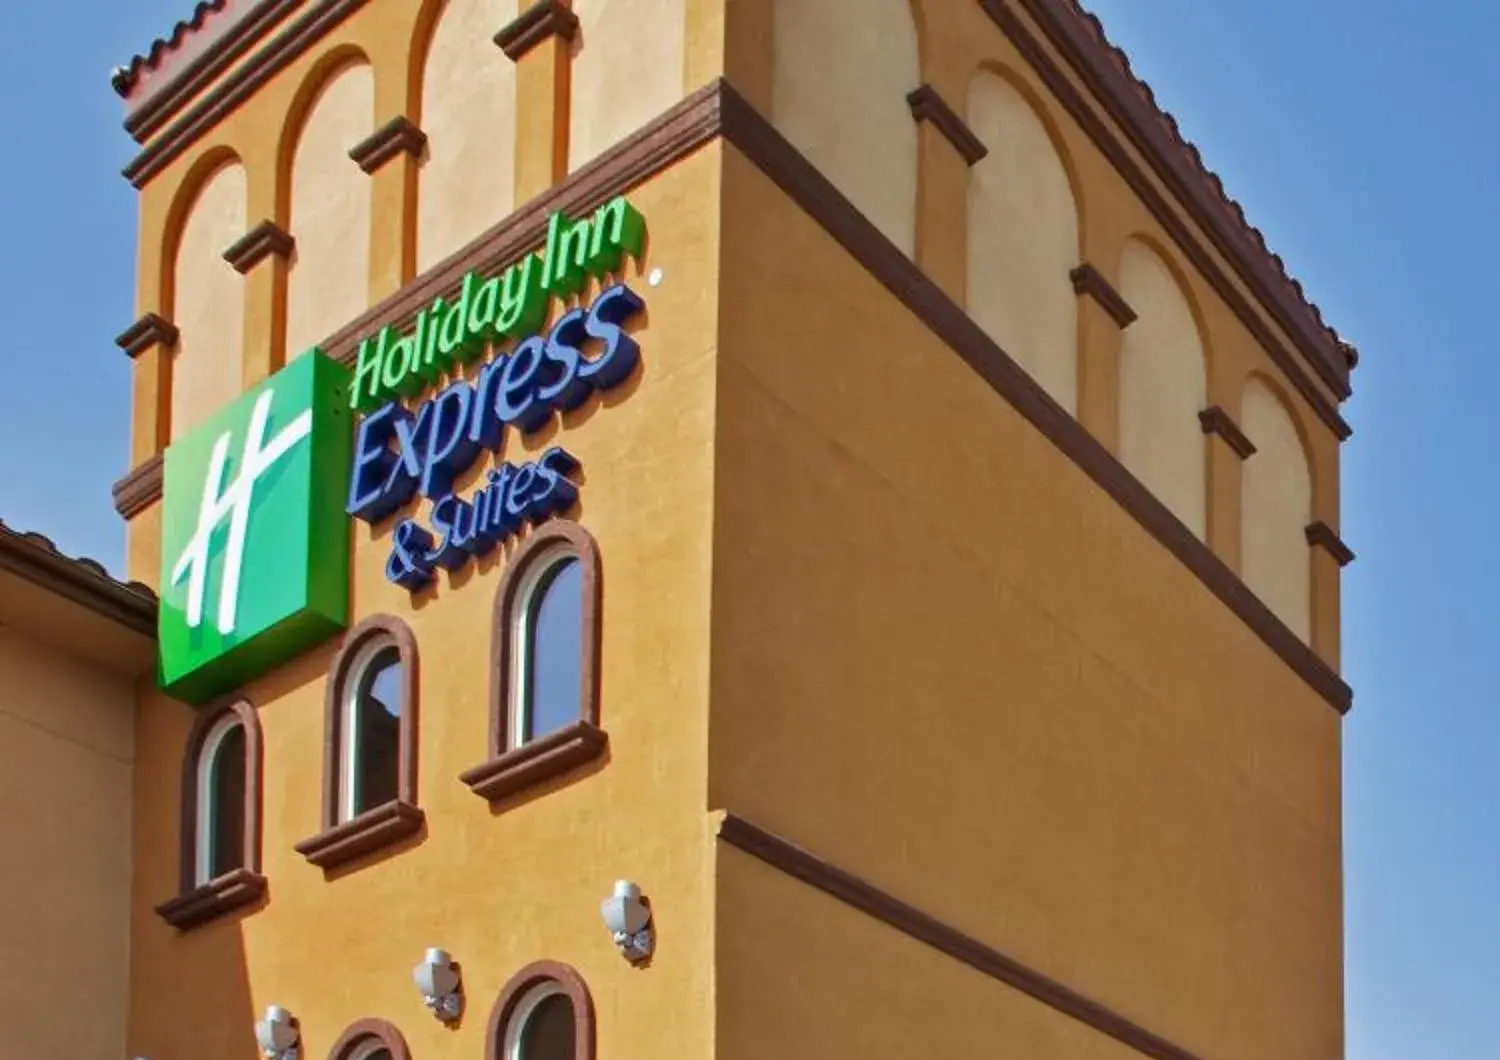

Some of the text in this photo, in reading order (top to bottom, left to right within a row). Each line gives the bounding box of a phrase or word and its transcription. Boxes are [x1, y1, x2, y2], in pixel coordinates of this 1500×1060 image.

[346, 283, 643, 524] Express
[350, 195, 646, 410] Holiday Inn
[385, 446, 581, 592] & Suites
